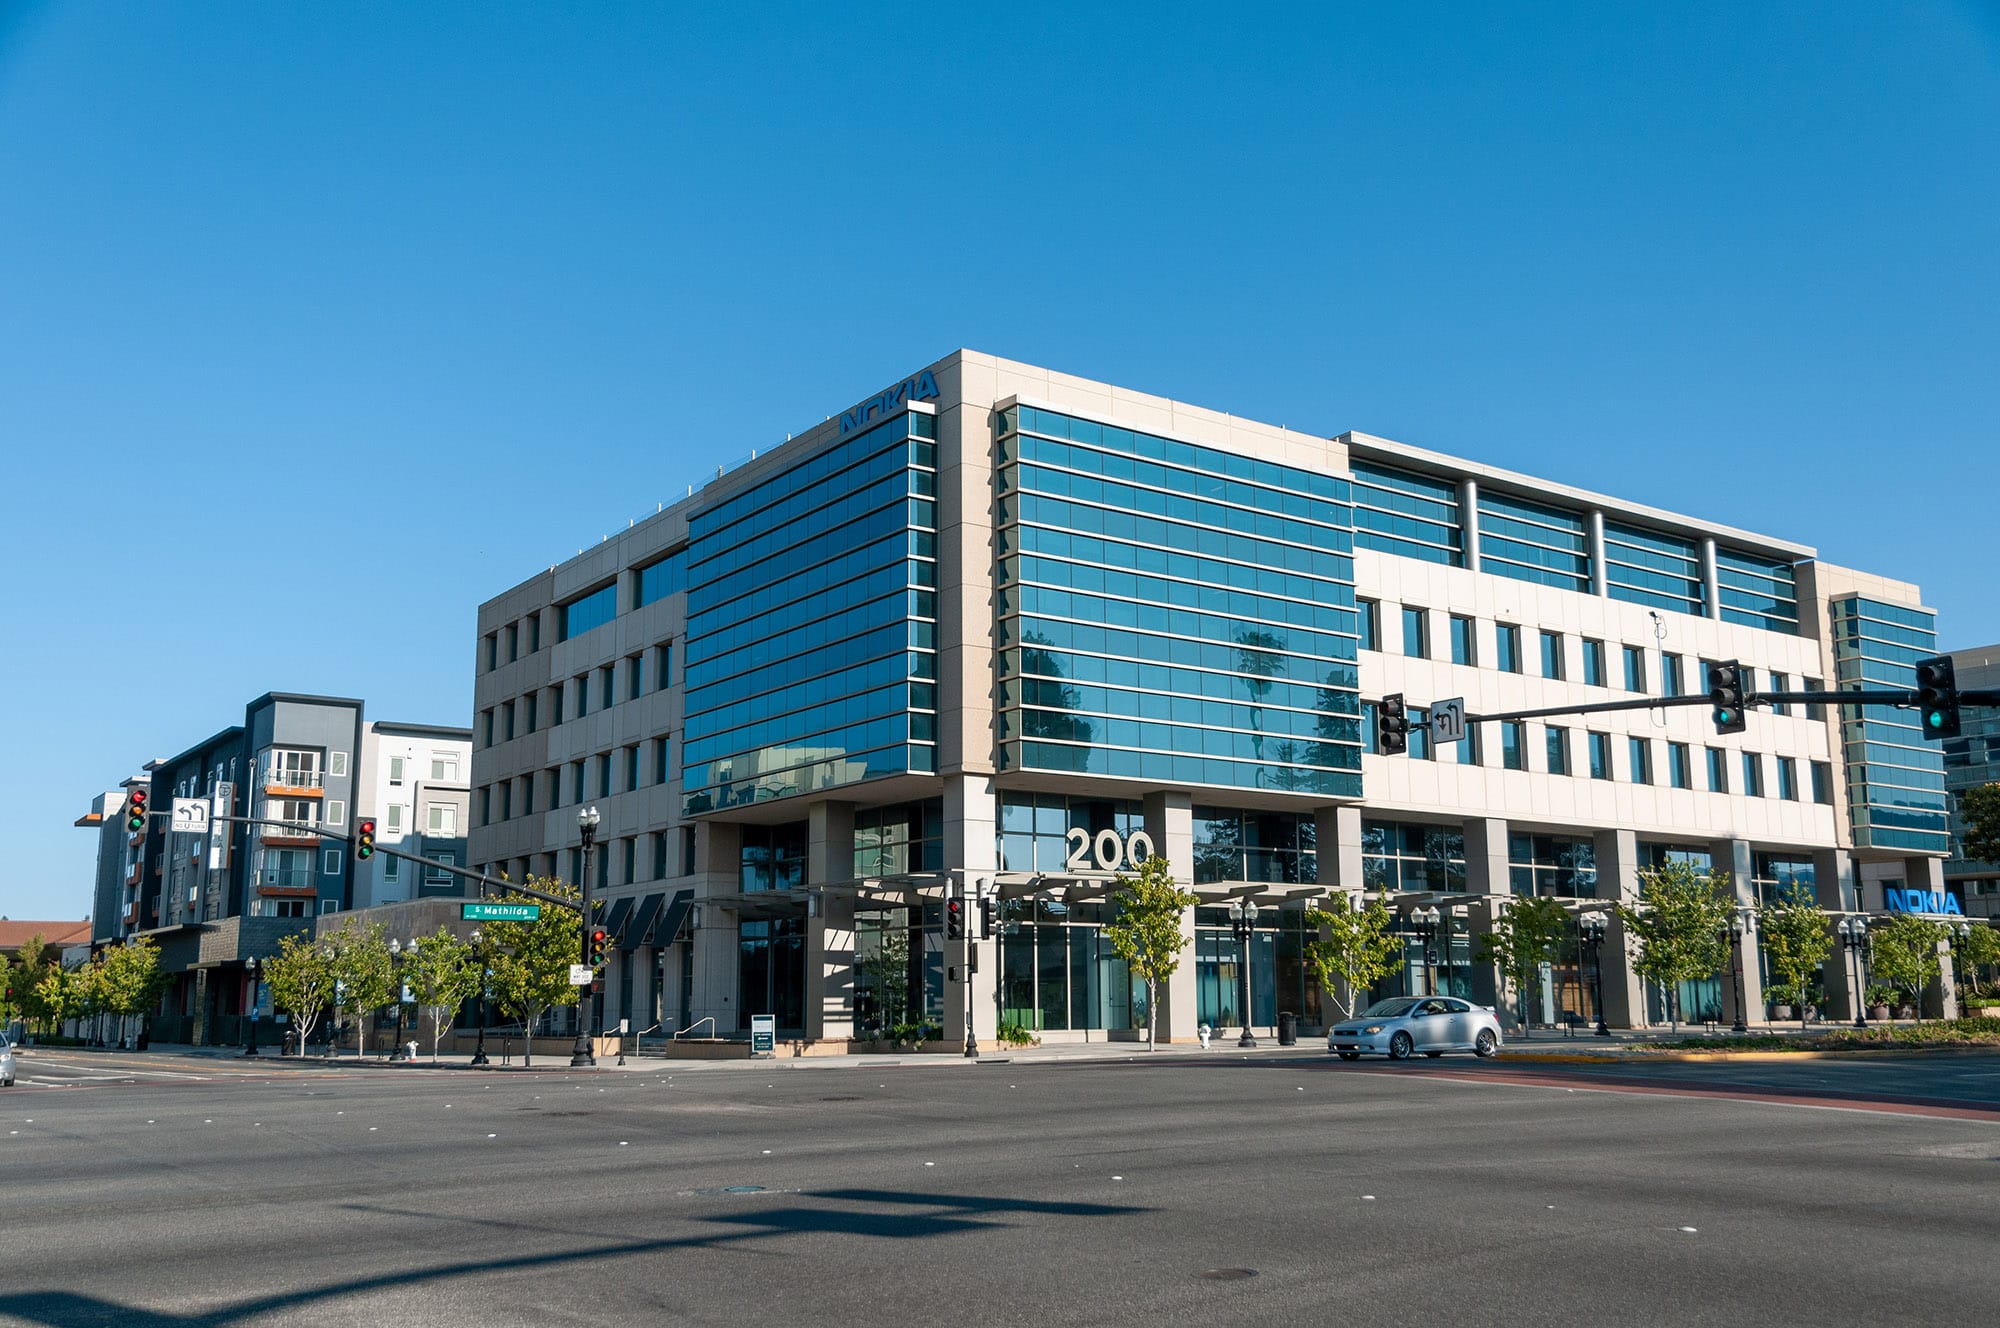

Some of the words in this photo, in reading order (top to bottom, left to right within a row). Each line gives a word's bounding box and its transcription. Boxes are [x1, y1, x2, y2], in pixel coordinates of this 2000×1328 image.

[839, 369, 940, 435] NOKIA
[1066, 827, 1155, 871] 200
[484, 906, 528, 915] Mathilda
[1886, 888, 1962, 915] NOKIA
